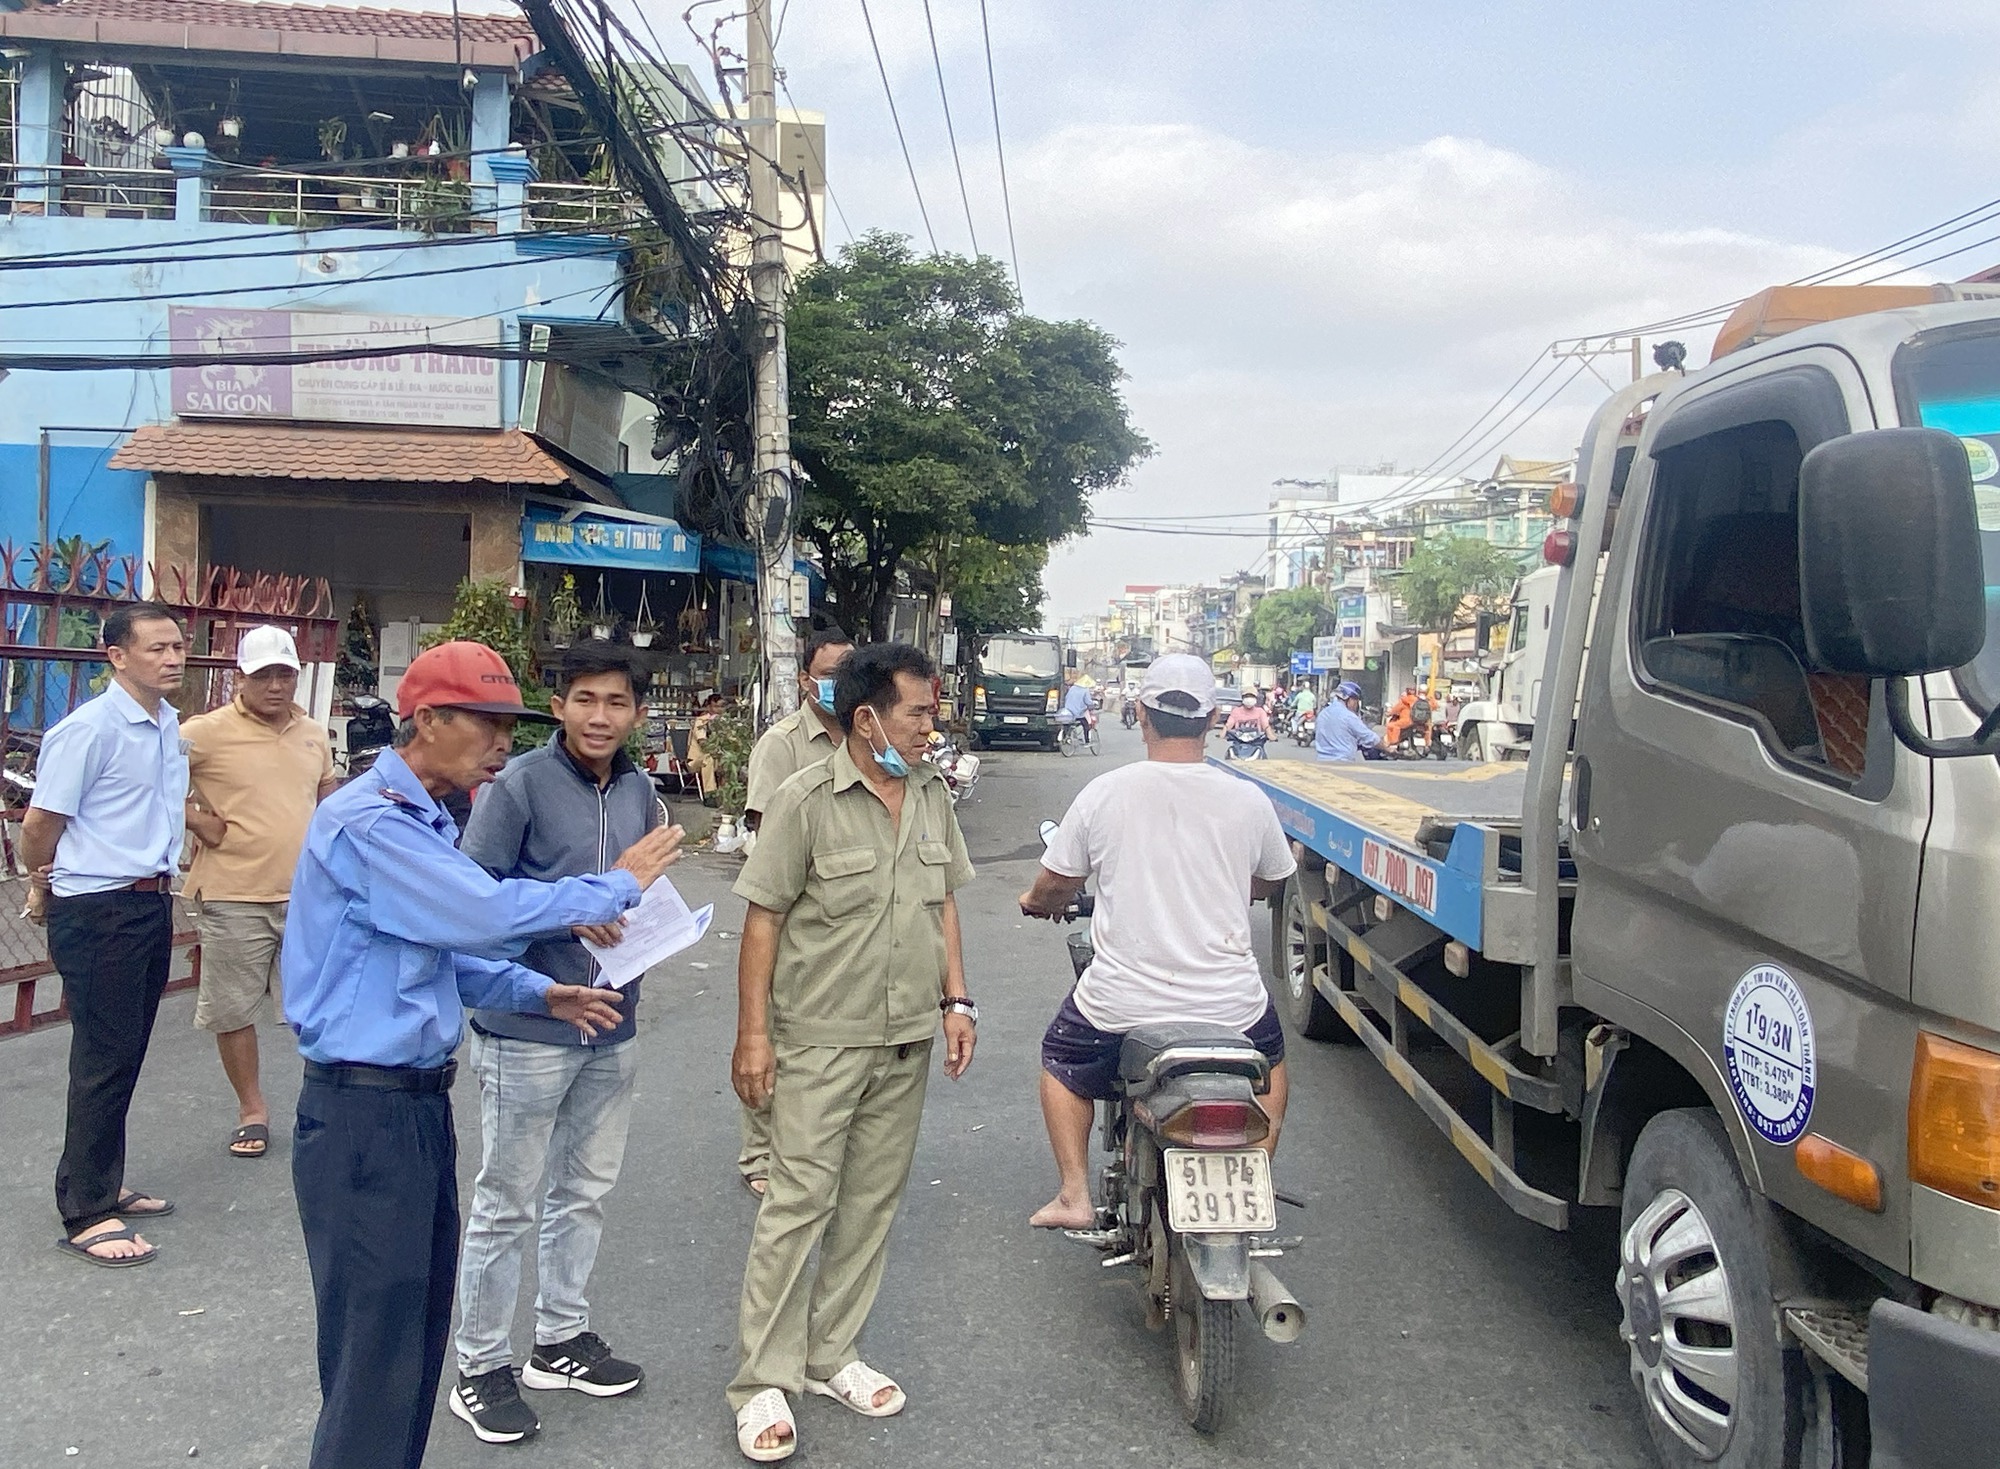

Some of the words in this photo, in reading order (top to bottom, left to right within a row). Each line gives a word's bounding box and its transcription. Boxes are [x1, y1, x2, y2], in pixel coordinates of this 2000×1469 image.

[403, 318, 423, 337] LÝ
[409, 350, 495, 377] TRANG
[215, 380, 243, 392] BIA
[186, 391, 273, 413] SAIGON
[1741, 1049, 1762, 1073] TTTP:
[1741, 1068, 1763, 1093] TTBT:
[1182, 1156, 1208, 1187] 51
[1186, 1191, 1259, 1222] 3915
